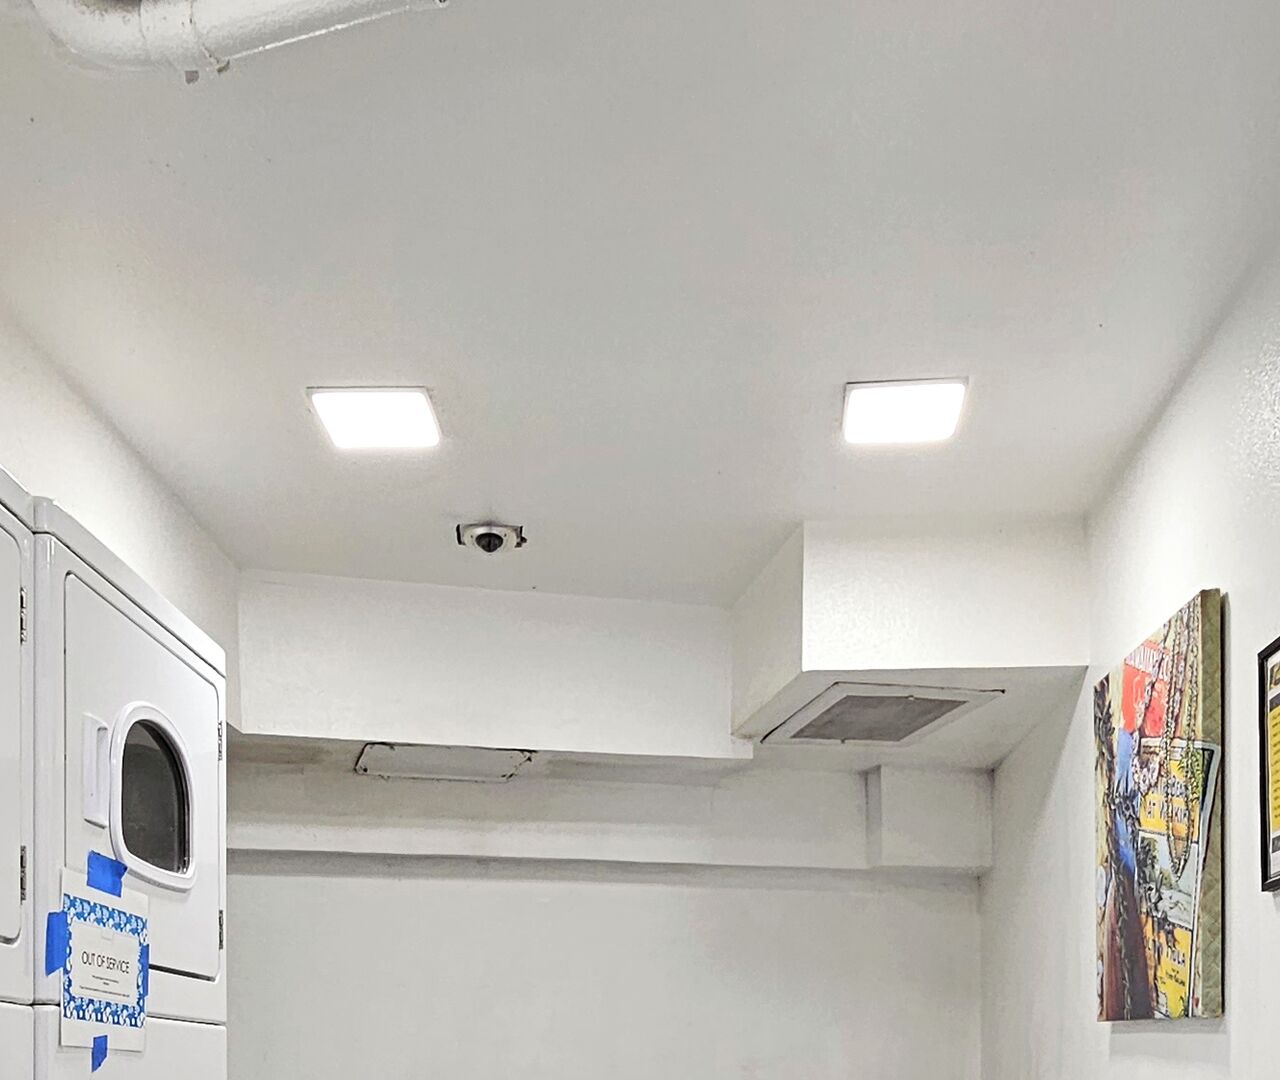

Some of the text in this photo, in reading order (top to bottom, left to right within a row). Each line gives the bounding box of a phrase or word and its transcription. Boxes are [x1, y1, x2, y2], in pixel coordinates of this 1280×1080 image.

[81, 950, 130, 974] OUT OF SERVICE
